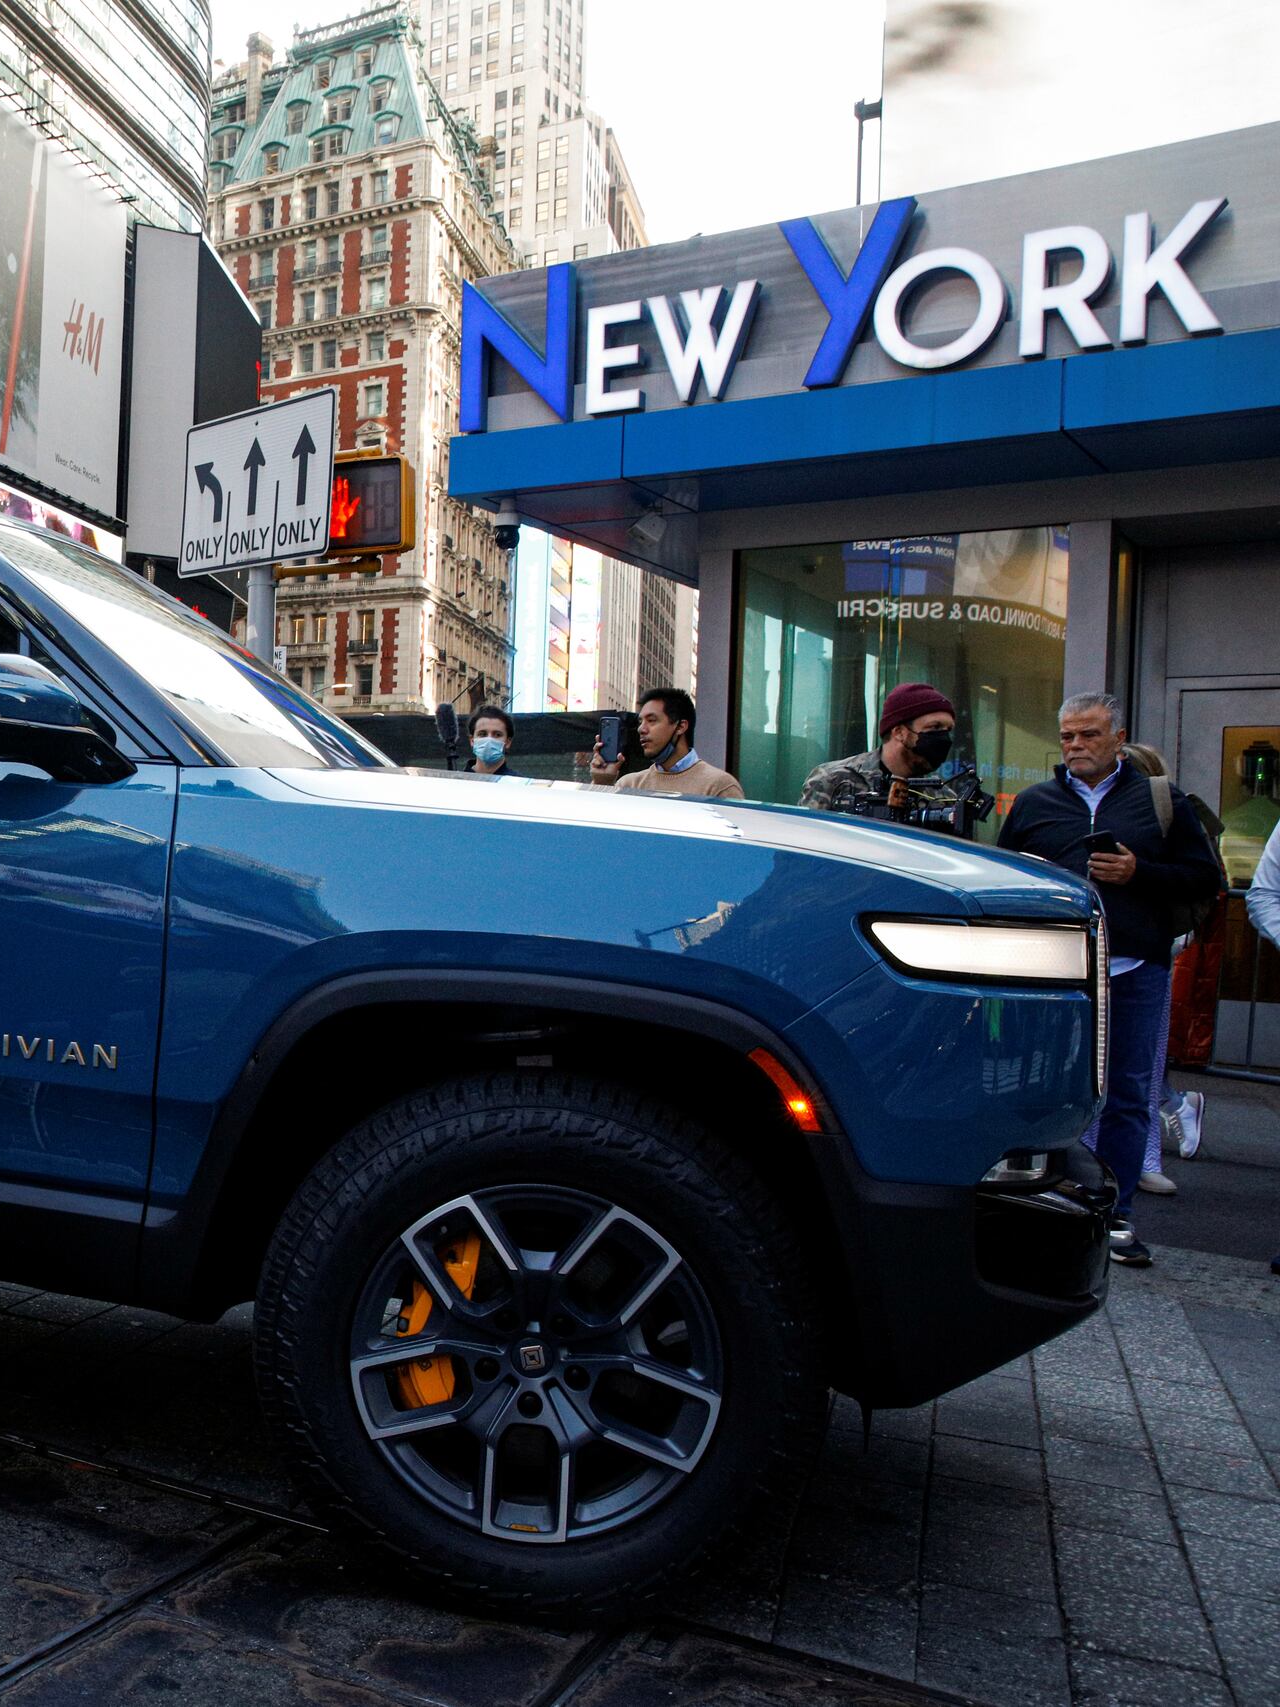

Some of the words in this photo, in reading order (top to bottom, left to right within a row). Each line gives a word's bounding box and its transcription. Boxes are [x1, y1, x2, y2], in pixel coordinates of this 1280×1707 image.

[63, 298, 106, 377] H&M
[459, 263, 761, 433] NEW
[778, 196, 1230, 389] YORK
[186, 534, 224, 562] ONLY
[229, 526, 271, 555] ONLY
[277, 516, 322, 547] ONLY
